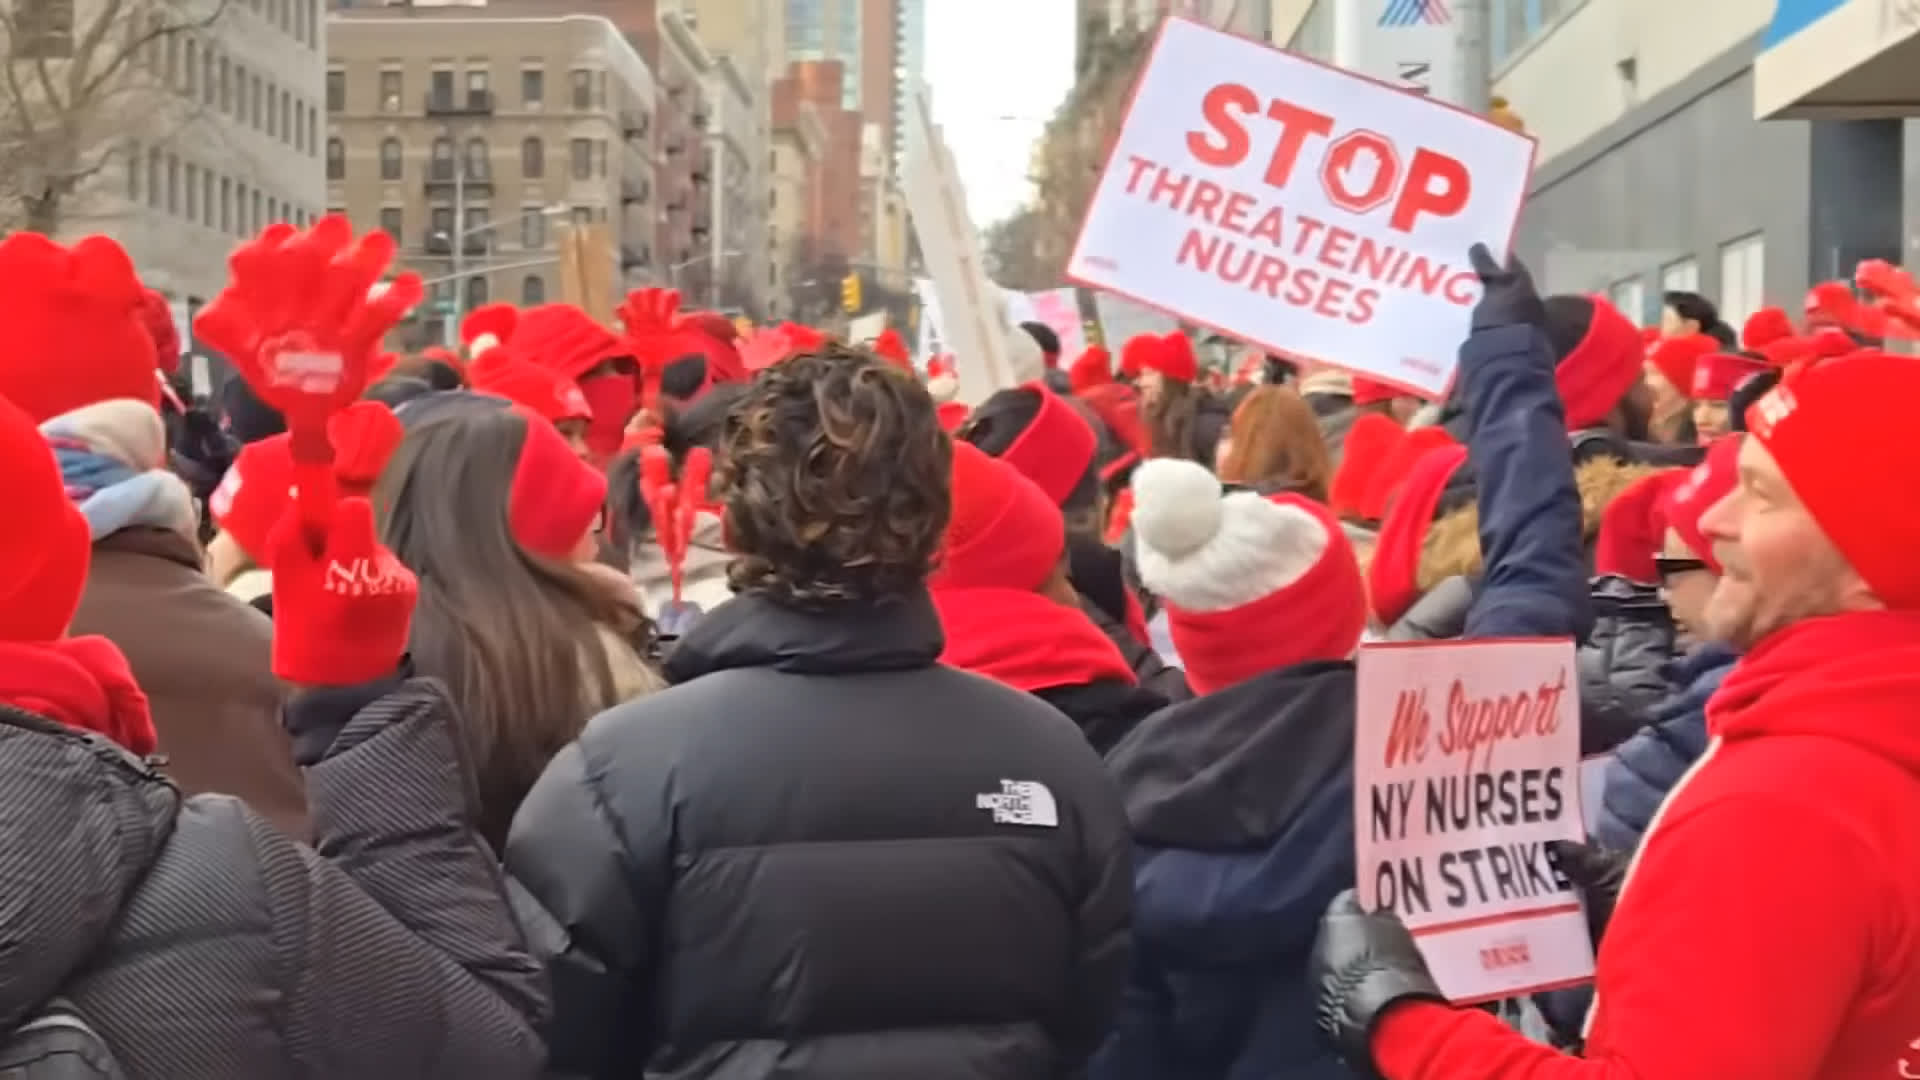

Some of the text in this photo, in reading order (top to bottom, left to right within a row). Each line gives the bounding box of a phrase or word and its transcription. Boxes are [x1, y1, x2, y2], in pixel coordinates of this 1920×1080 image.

[1186, 83, 1471, 233] STOP
[1123, 155, 1481, 307] THREATENING
[1175, 229, 1380, 326] NURSES
[1384, 667, 1566, 773] We Support
[1000, 779, 1032, 795] THE
[1371, 767, 1565, 842] NY NURSES
[1376, 856, 1431, 915] ON
